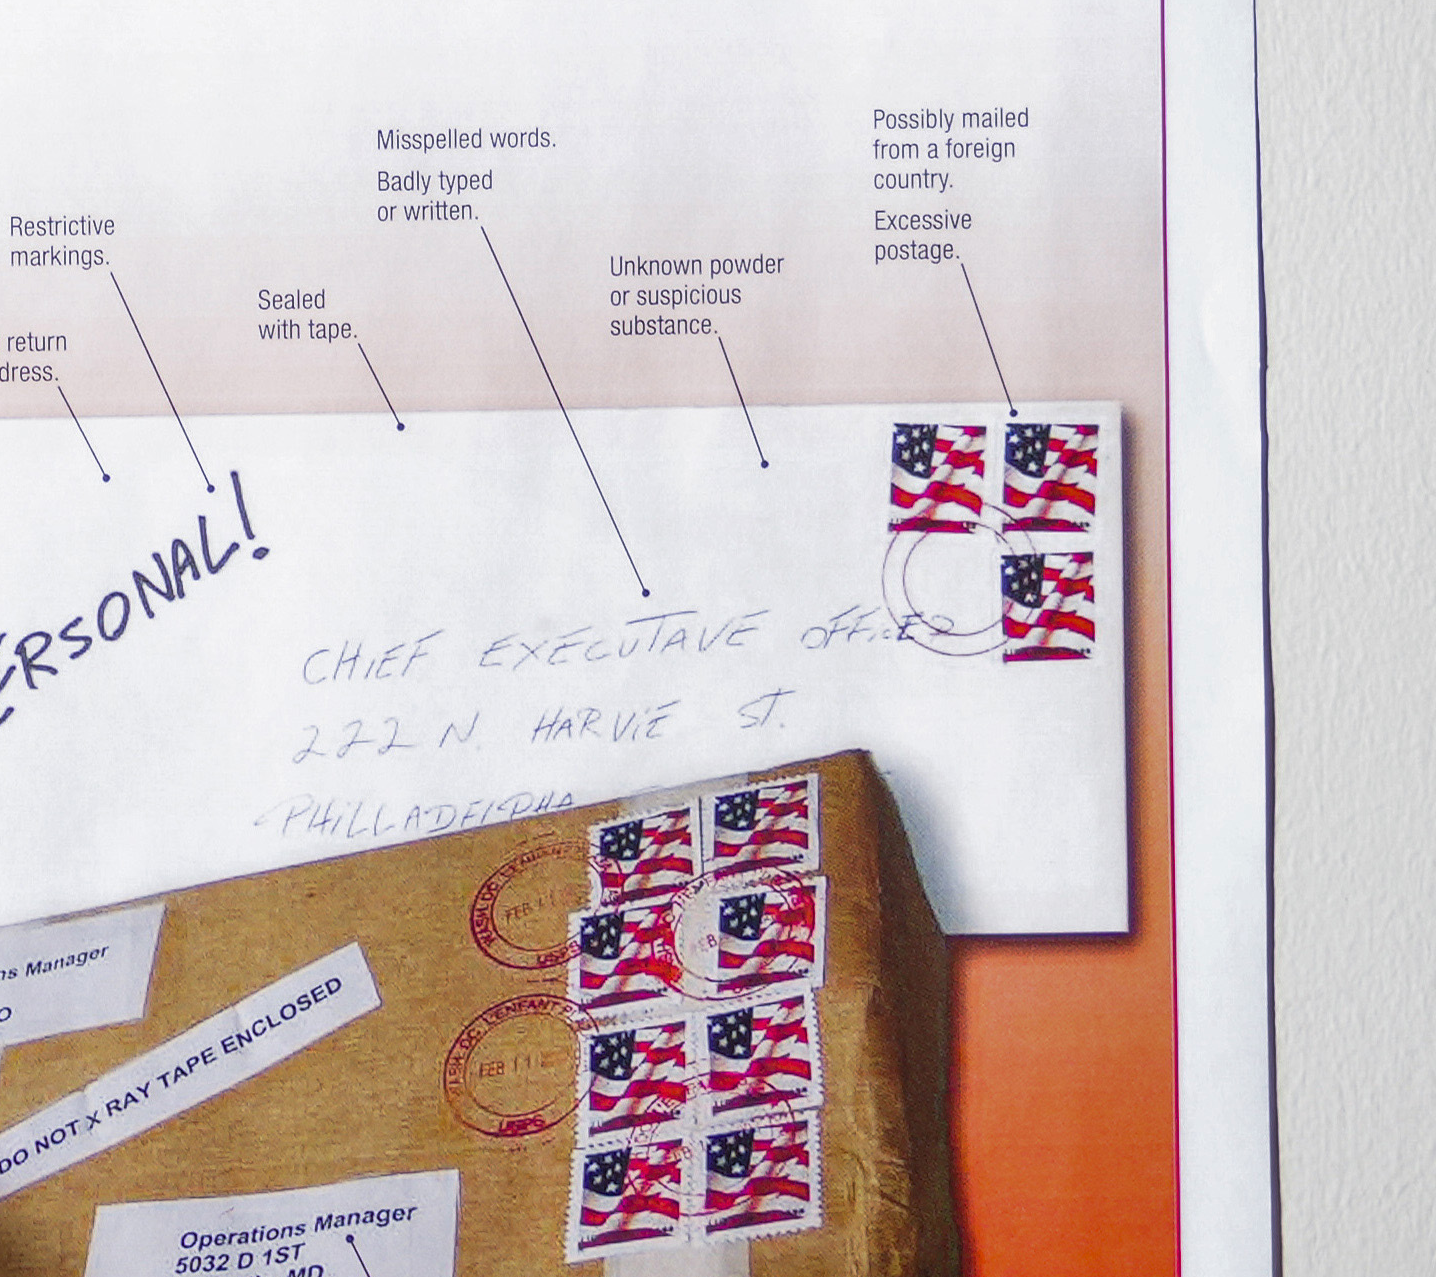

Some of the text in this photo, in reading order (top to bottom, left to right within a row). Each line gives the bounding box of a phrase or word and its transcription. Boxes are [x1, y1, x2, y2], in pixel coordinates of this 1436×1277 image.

[377, 127, 551, 153] Misspelled words.
[10, 215, 115, 237] Restrictive
[11, 245, 110, 271] markings.
[179, 1205, 419, 1252] Operations Manager
